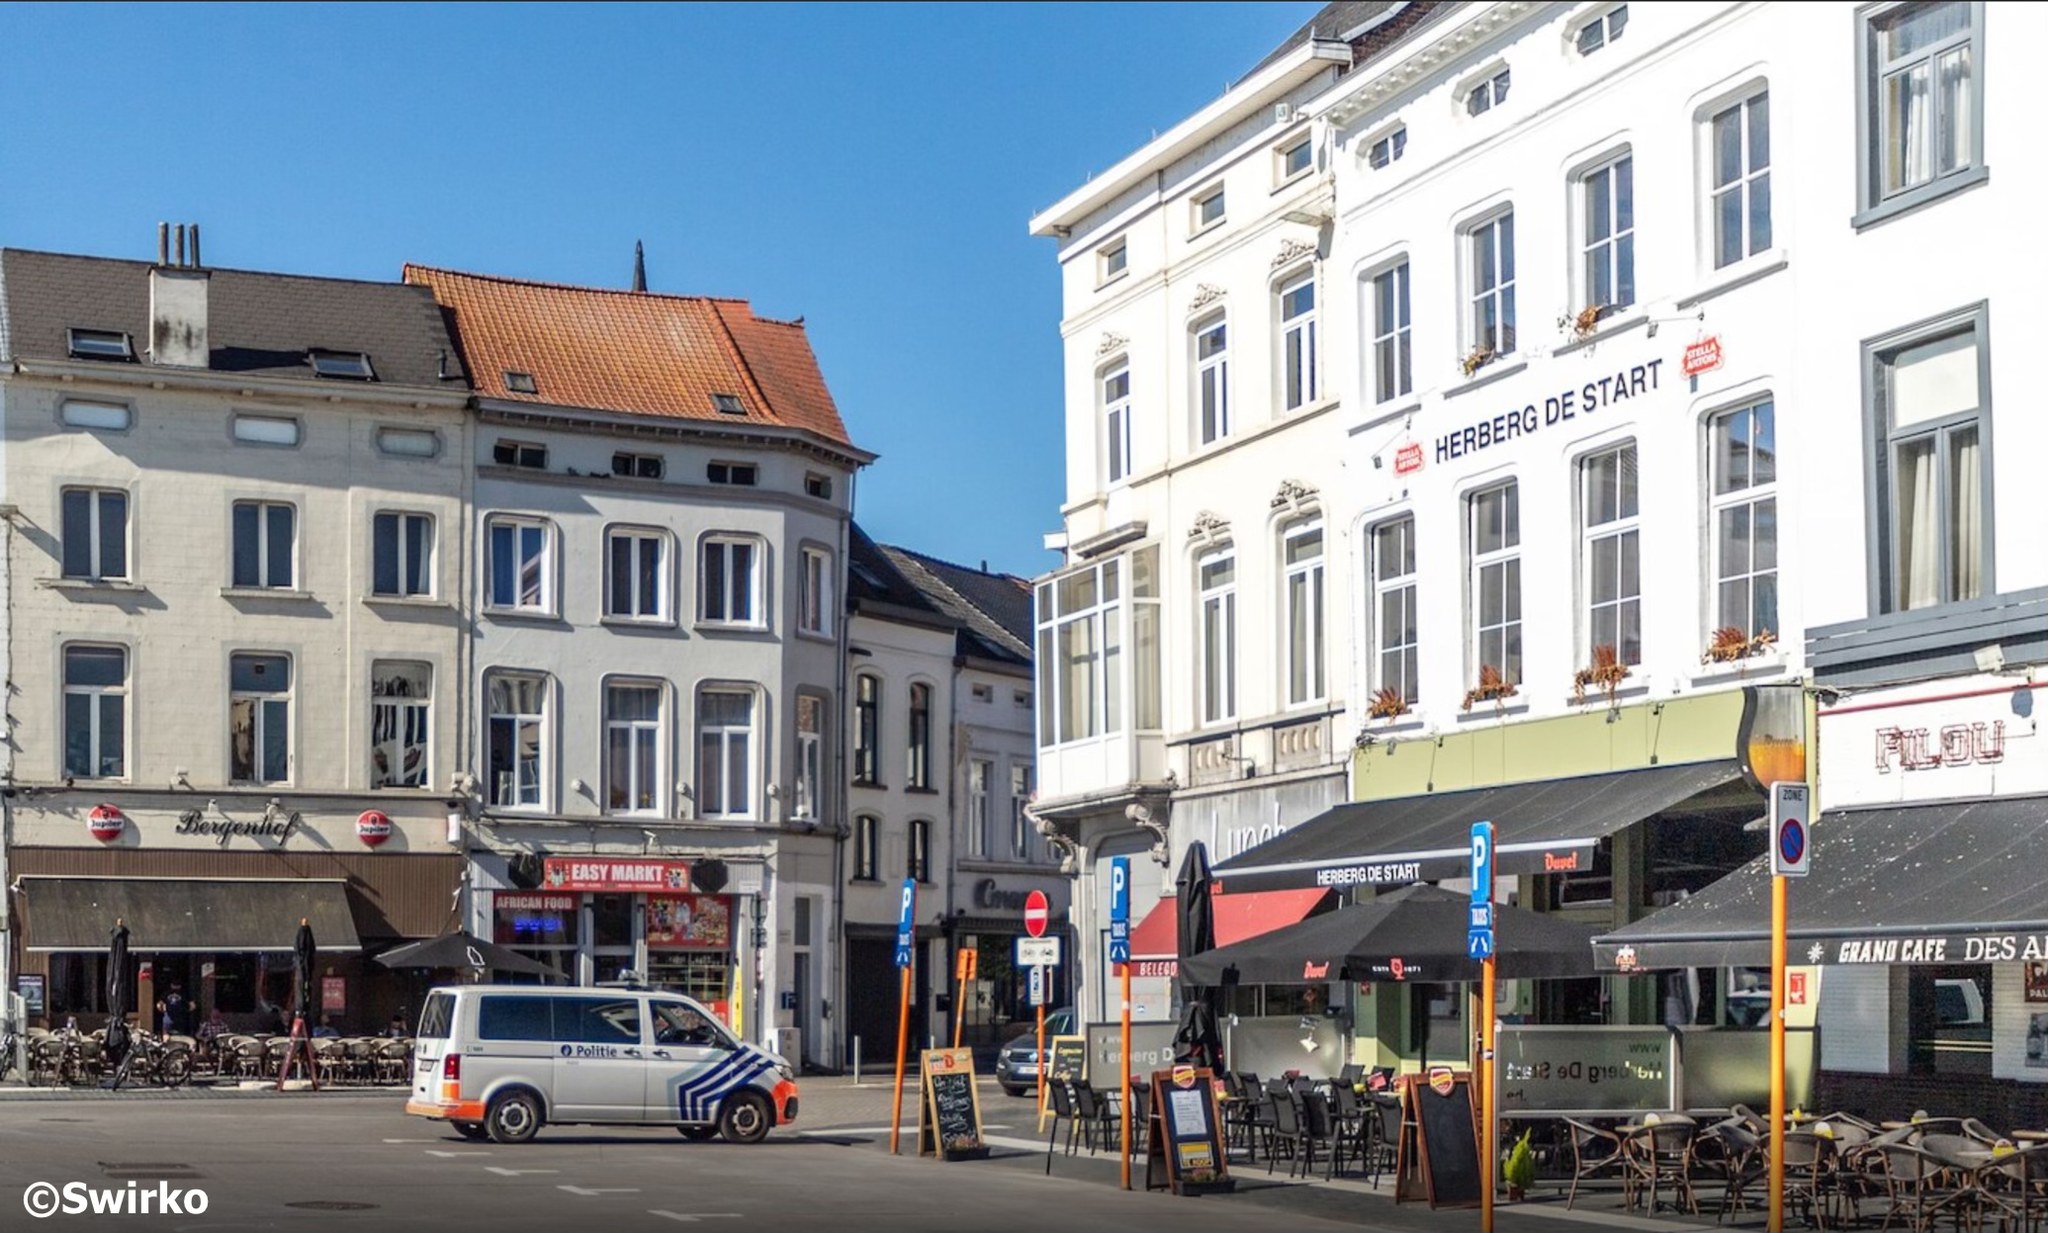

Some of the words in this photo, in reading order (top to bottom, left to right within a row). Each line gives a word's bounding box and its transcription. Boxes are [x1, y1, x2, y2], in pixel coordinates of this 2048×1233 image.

[1436, 405, 1537, 464] HERBERG
[1545, 391, 1575, 426] DE
[1583, 358, 1663, 413] START
[1875, 720, 2005, 774] PILOU
[1783, 789, 1803, 800] ZONE
[91, 819, 122, 830] Jupiler
[176, 808, 300, 845] Bergenhof
[359, 824, 389, 834] Jupiler
[1473, 836, 1486, 890] P
[1544, 852, 1578, 871] Duvel
[572, 864, 608, 881] EASY
[612, 865, 663, 882] MARKT
[1317, 867, 1367, 885] HERBERG
[1368, 866, 1382, 881] DE
[1384, 863, 1421, 880] START
[1112, 866, 1124, 909] P
[497, 897, 541, 908] AFRICAN
[544, 897, 572, 908] FOOD
[901, 887, 911, 922] P
[1838, 939, 1898, 963] GRAND
[1964, 936, 2016, 961] DES
[577, 1044, 617, 1058] Politie
